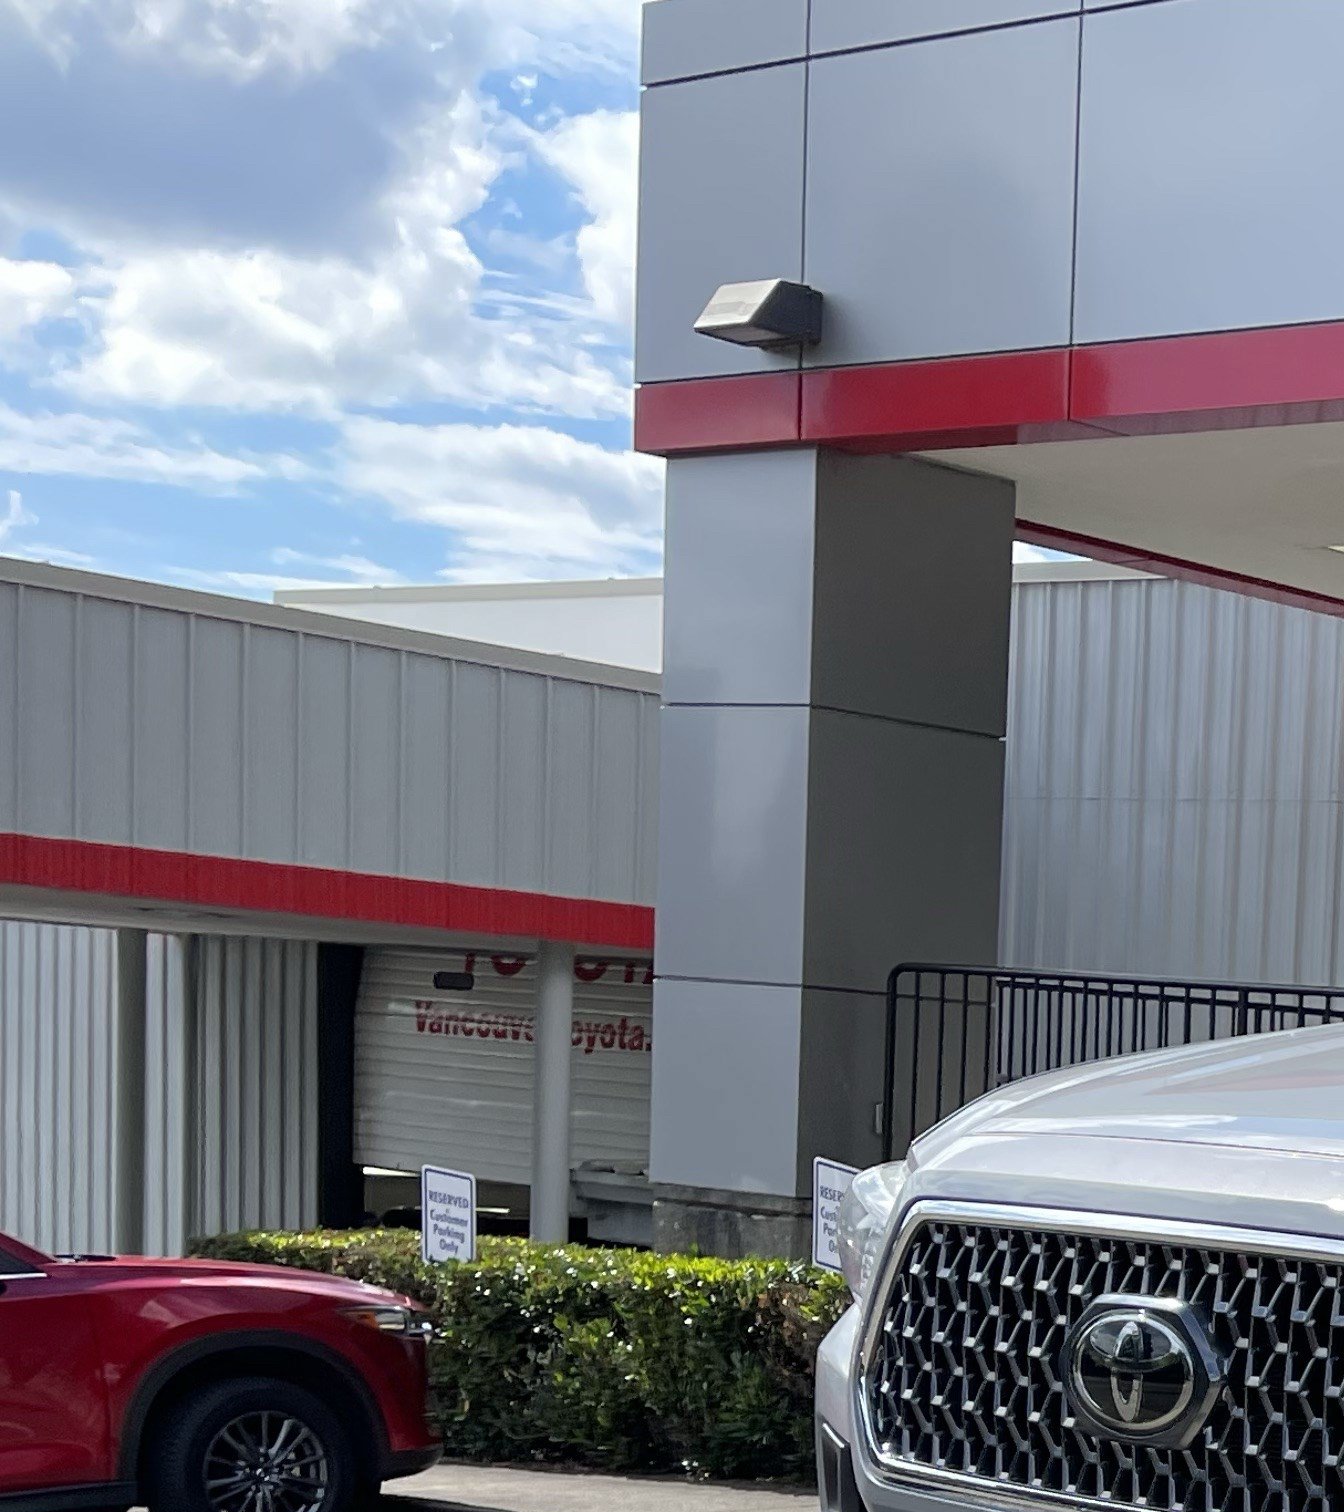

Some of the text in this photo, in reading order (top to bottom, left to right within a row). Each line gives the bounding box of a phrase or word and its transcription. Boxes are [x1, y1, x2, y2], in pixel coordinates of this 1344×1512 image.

[429, 1190, 469, 1208] RESERVED
[430, 1209, 468, 1227] Customer
[433, 1223, 465, 1244] Parking
[439, 1238, 458, 1254] Only
